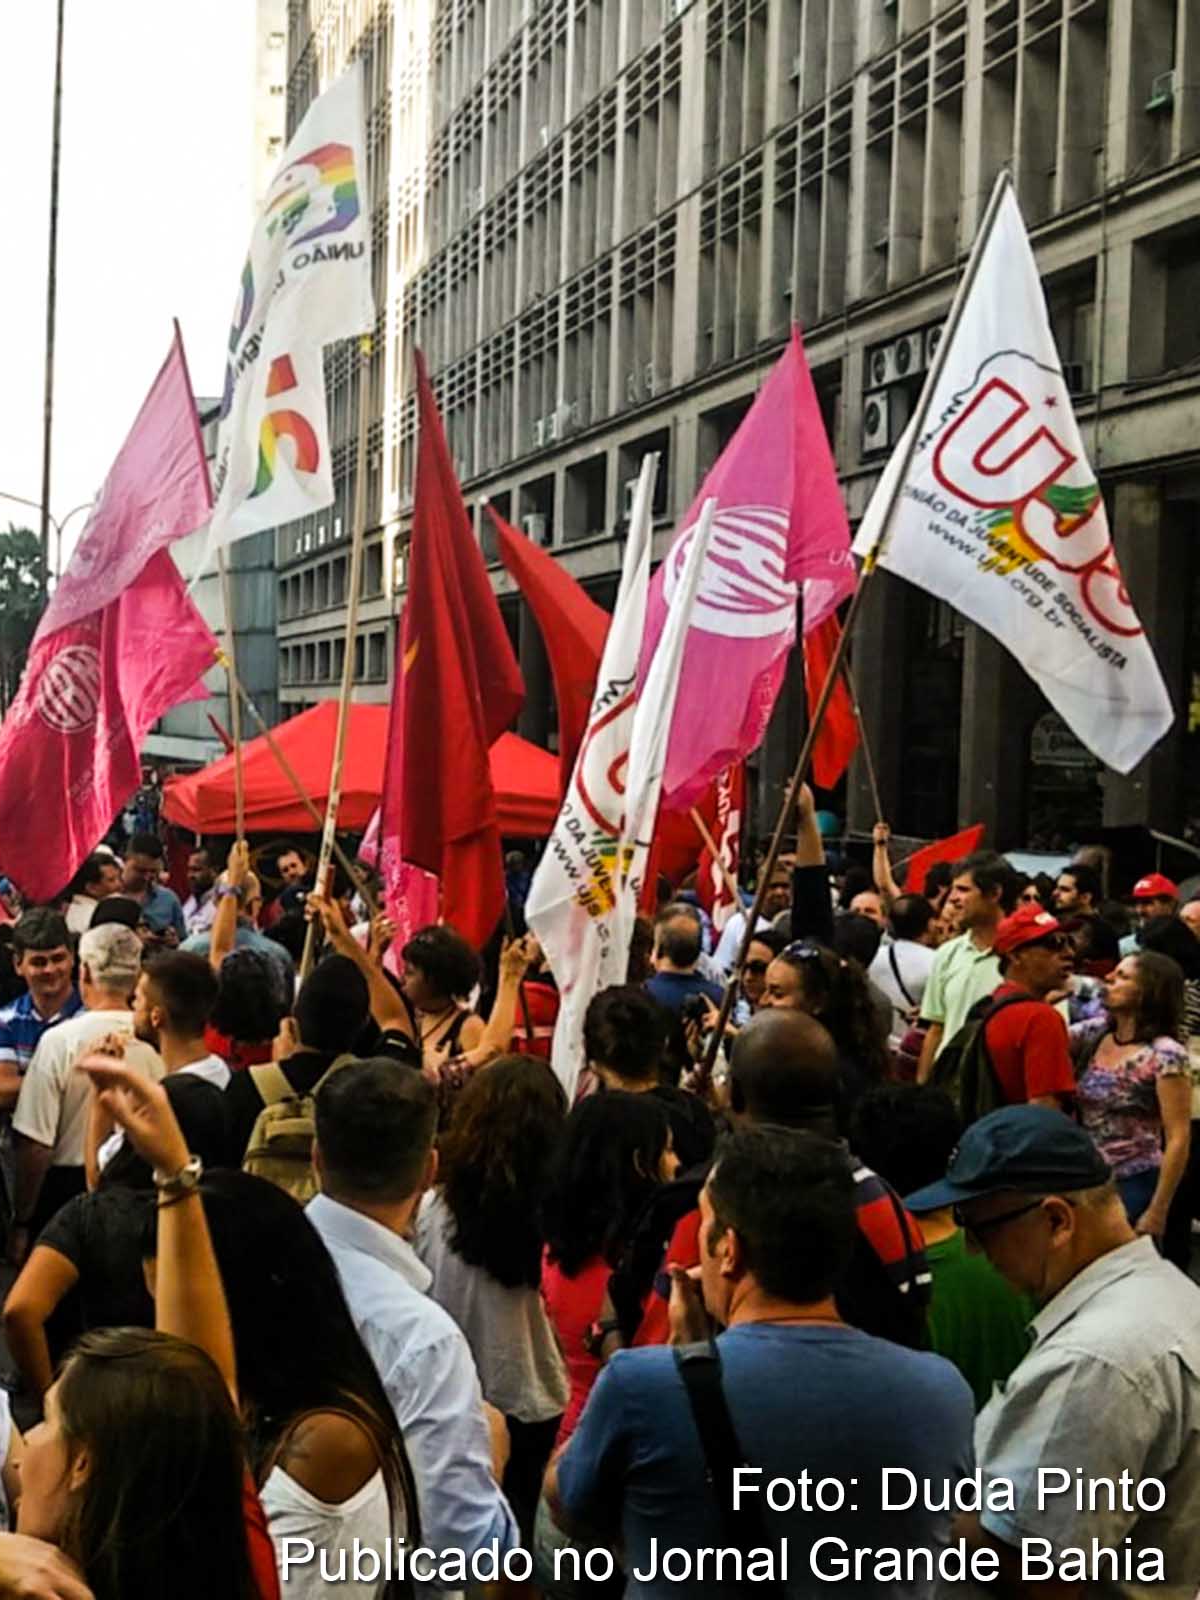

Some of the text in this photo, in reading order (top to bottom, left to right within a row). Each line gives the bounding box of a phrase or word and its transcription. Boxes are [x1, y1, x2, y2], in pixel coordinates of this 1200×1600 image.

[928, 521, 1067, 629] www.ujs.org.br
[945, 509, 969, 528] DA
[967, 524, 1057, 593] JUVENTUDE
[1052, 592, 1129, 670] SOCIALISTA
